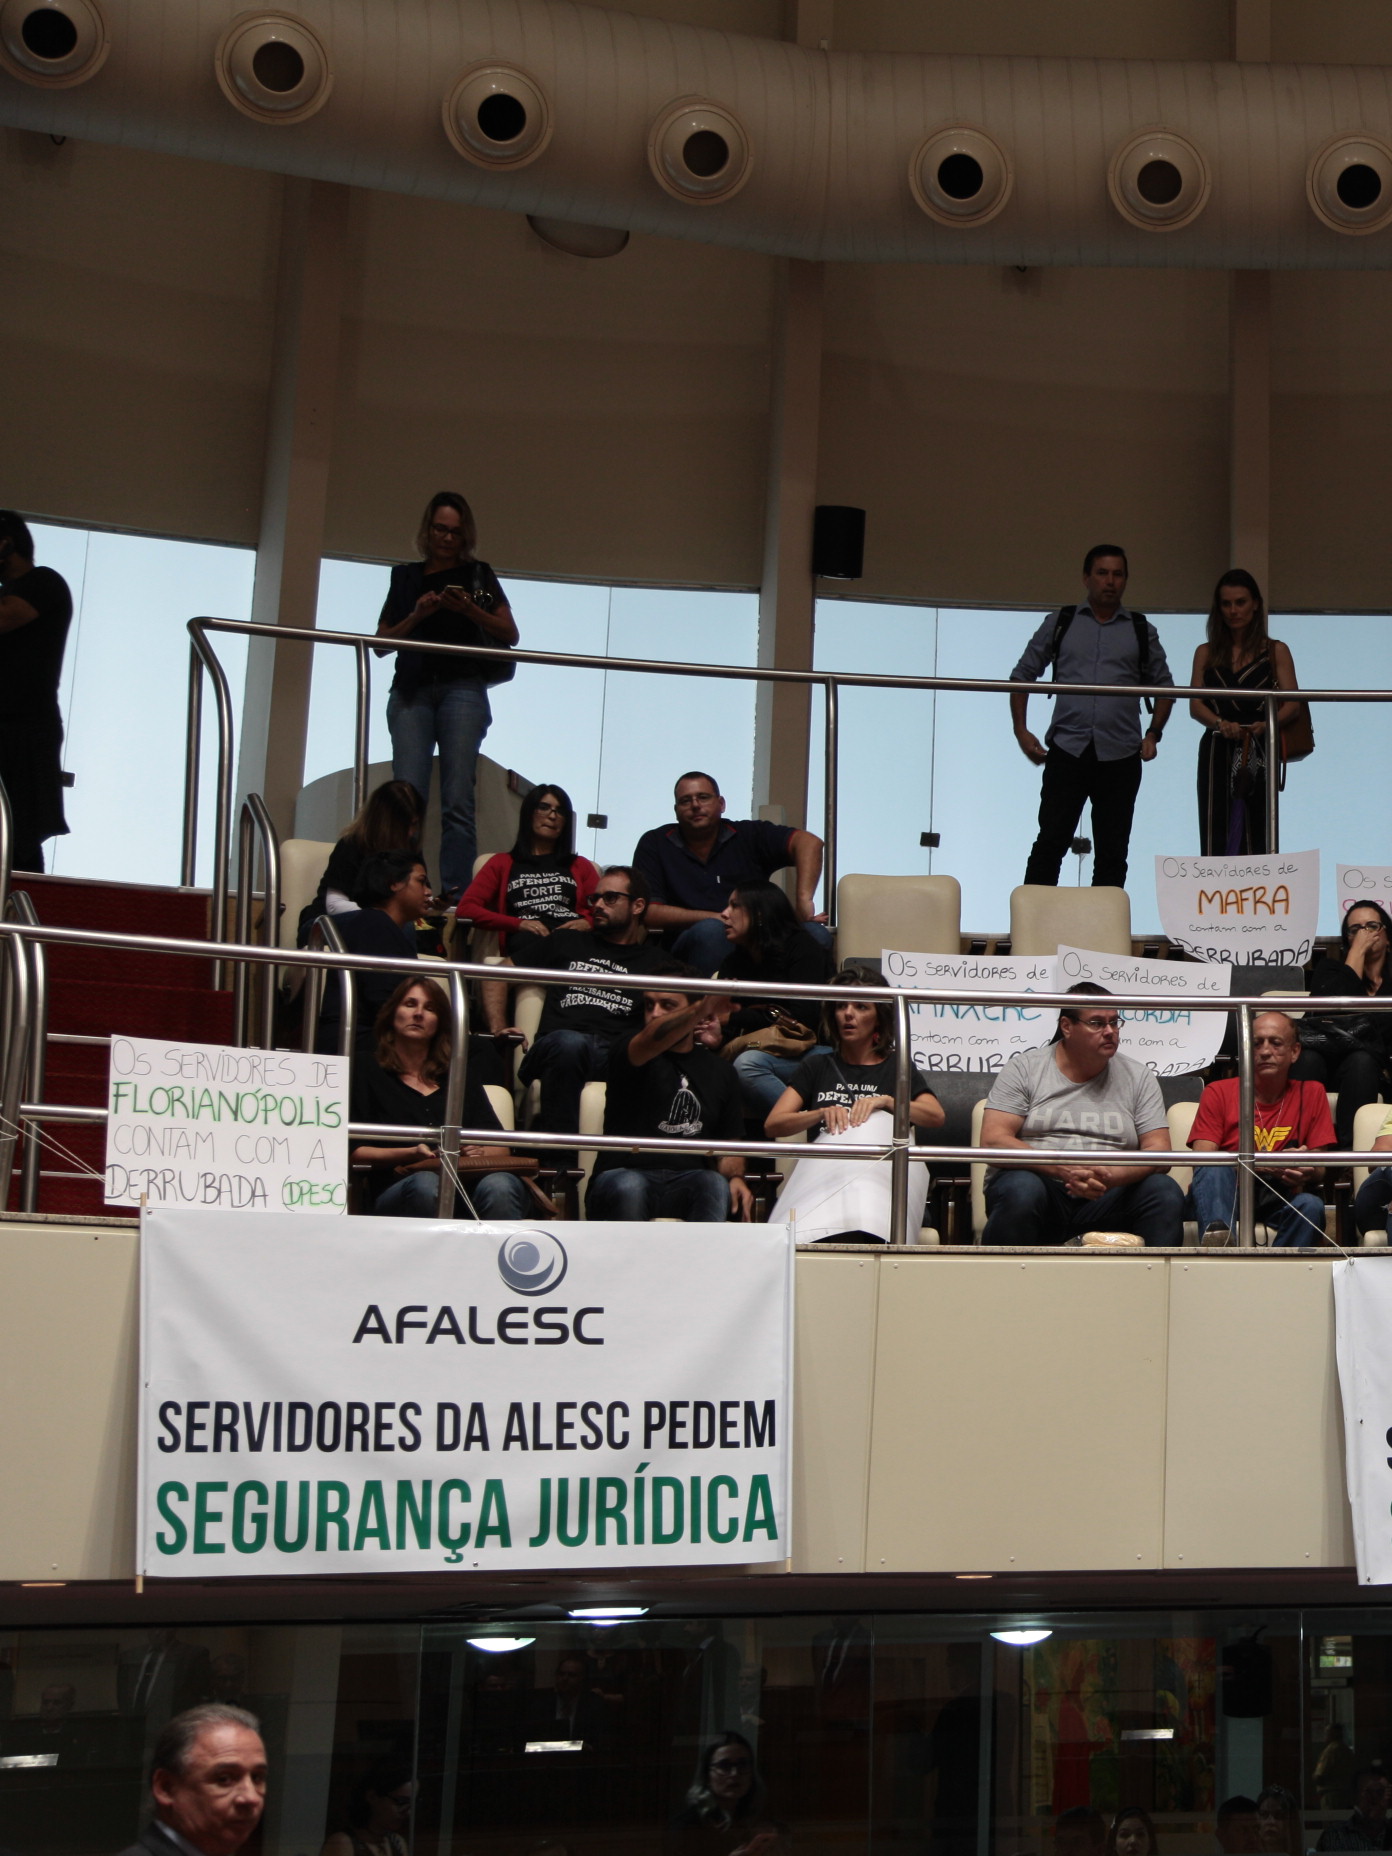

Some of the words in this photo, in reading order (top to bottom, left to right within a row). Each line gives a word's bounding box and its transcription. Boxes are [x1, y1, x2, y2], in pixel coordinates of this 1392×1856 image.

[1278, 858, 1299, 874] de
[507, 876, 577, 892] DEFENSORIA
[523, 885, 562, 898] FORTE
[1197, 884, 1290, 915] MAFRA
[1189, 921, 1237, 934] contam
[1273, 922, 1287, 932] a
[1173, 937, 1312, 967] DERRUBADA
[611, 962, 628, 974] UMA
[1026, 965, 1049, 981] de
[1197, 977, 1221, 991] de
[910, 1030, 963, 1045] ontam
[968, 1034, 1000, 1046] com
[1010, 1035, 1027, 1044] a
[1138, 1037, 1163, 1047] com
[1169, 1037, 1187, 1048] a
[161, 1048, 296, 1086] SERVIDORES
[306, 1061, 339, 1088] DE
[112, 1082, 341, 1129] FLORIANÓPOLIS
[1027, 1108, 1125, 1134] HARD
[113, 1124, 215, 1163] CONTAM
[235, 1134, 290, 1165] COM
[307, 1139, 327, 1171] A
[105, 1164, 269, 1208] DERRUBADA
[352, 1304, 605, 1346] AFALESC
[156, 1400, 422, 1453] SERVIDORES
[437, 1401, 490, 1452] DA
[502, 1400, 630, 1451] ALESC
[643, 1399, 776, 1450] PEDEM
[155, 1477, 512, 1564] SEGURANÇA
[529, 1461, 779, 1548] JURÍDICA
